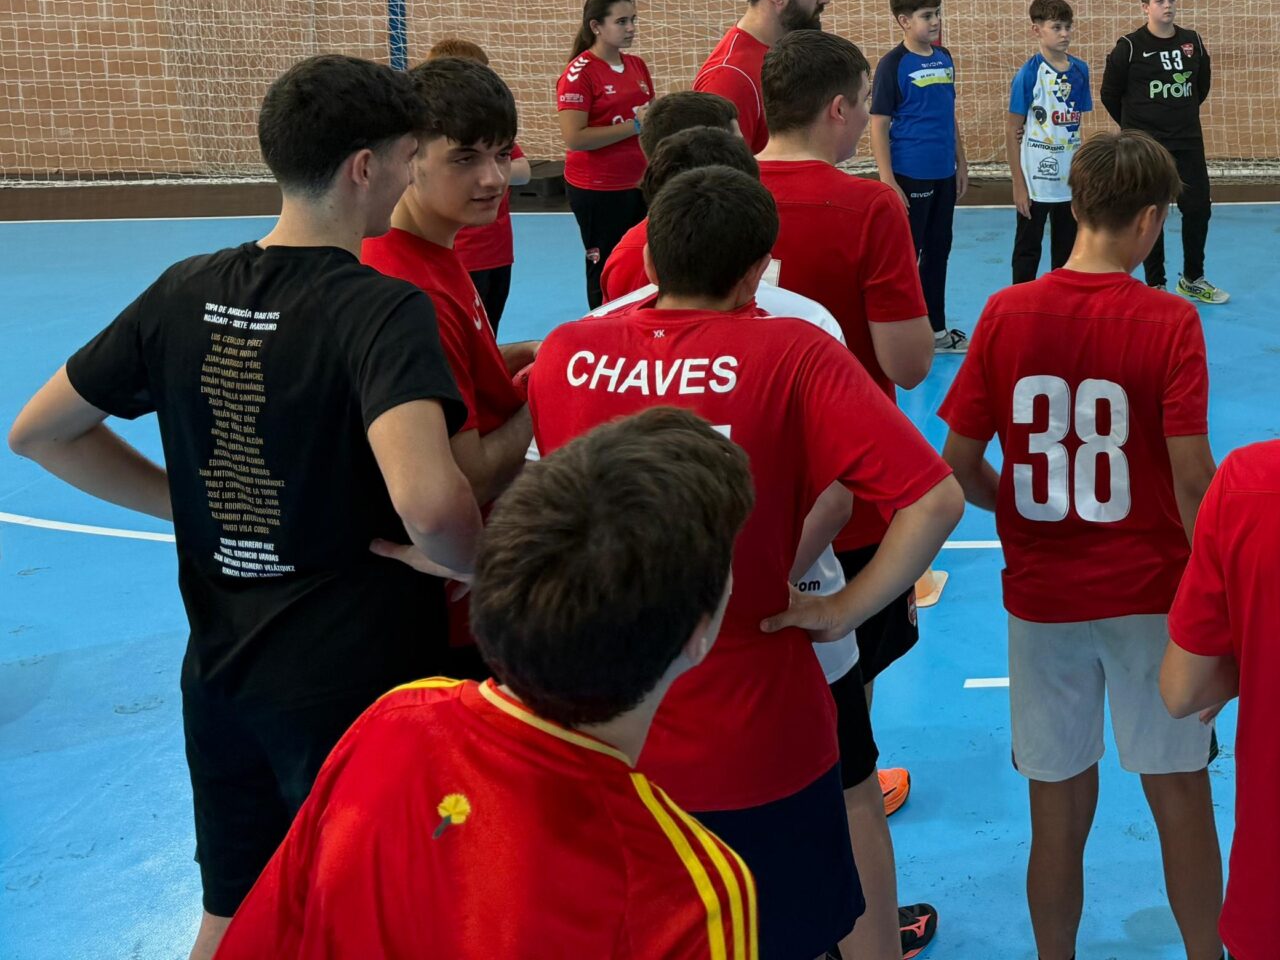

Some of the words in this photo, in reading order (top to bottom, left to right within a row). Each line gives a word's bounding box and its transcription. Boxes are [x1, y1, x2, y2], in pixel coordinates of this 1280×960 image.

[1160, 50, 1184, 70] 53
[566, 350, 738, 396] CHAVES
[1012, 374, 1131, 522] 38
